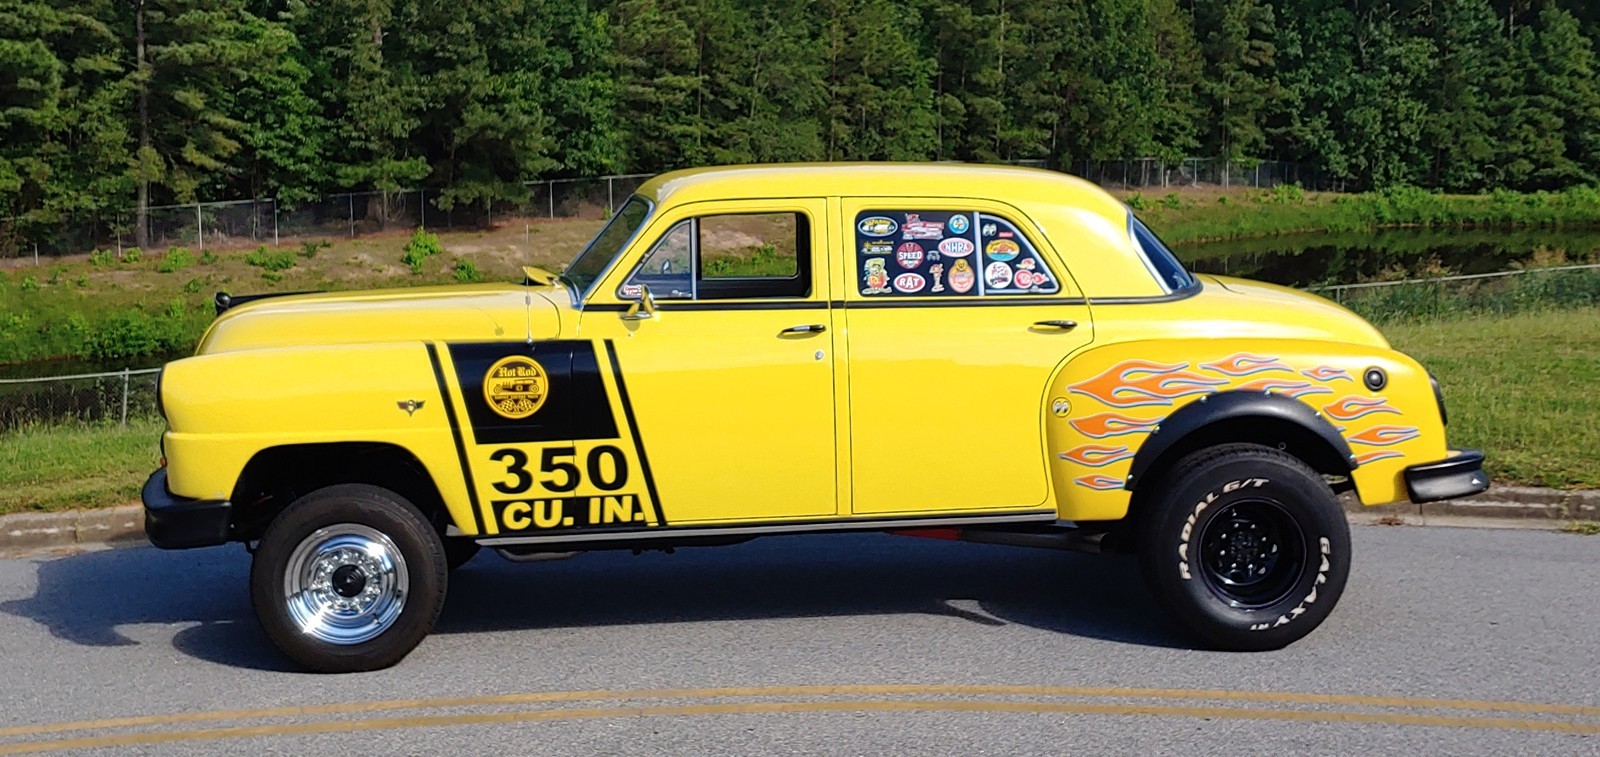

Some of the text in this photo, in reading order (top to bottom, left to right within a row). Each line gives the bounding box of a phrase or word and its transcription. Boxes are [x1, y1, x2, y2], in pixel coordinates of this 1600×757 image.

[898, 250, 923, 261] SPEED
[944, 242, 969, 254] NHRA
[899, 275, 920, 289] RAT
[498, 366, 537, 377] Hot Rod
[489, 445, 630, 495] 350
[502, 495, 645, 531] CU. IN.
[1178, 477, 1271, 580] RADIAL G/T
[1273, 536, 1332, 628] GALAXY
